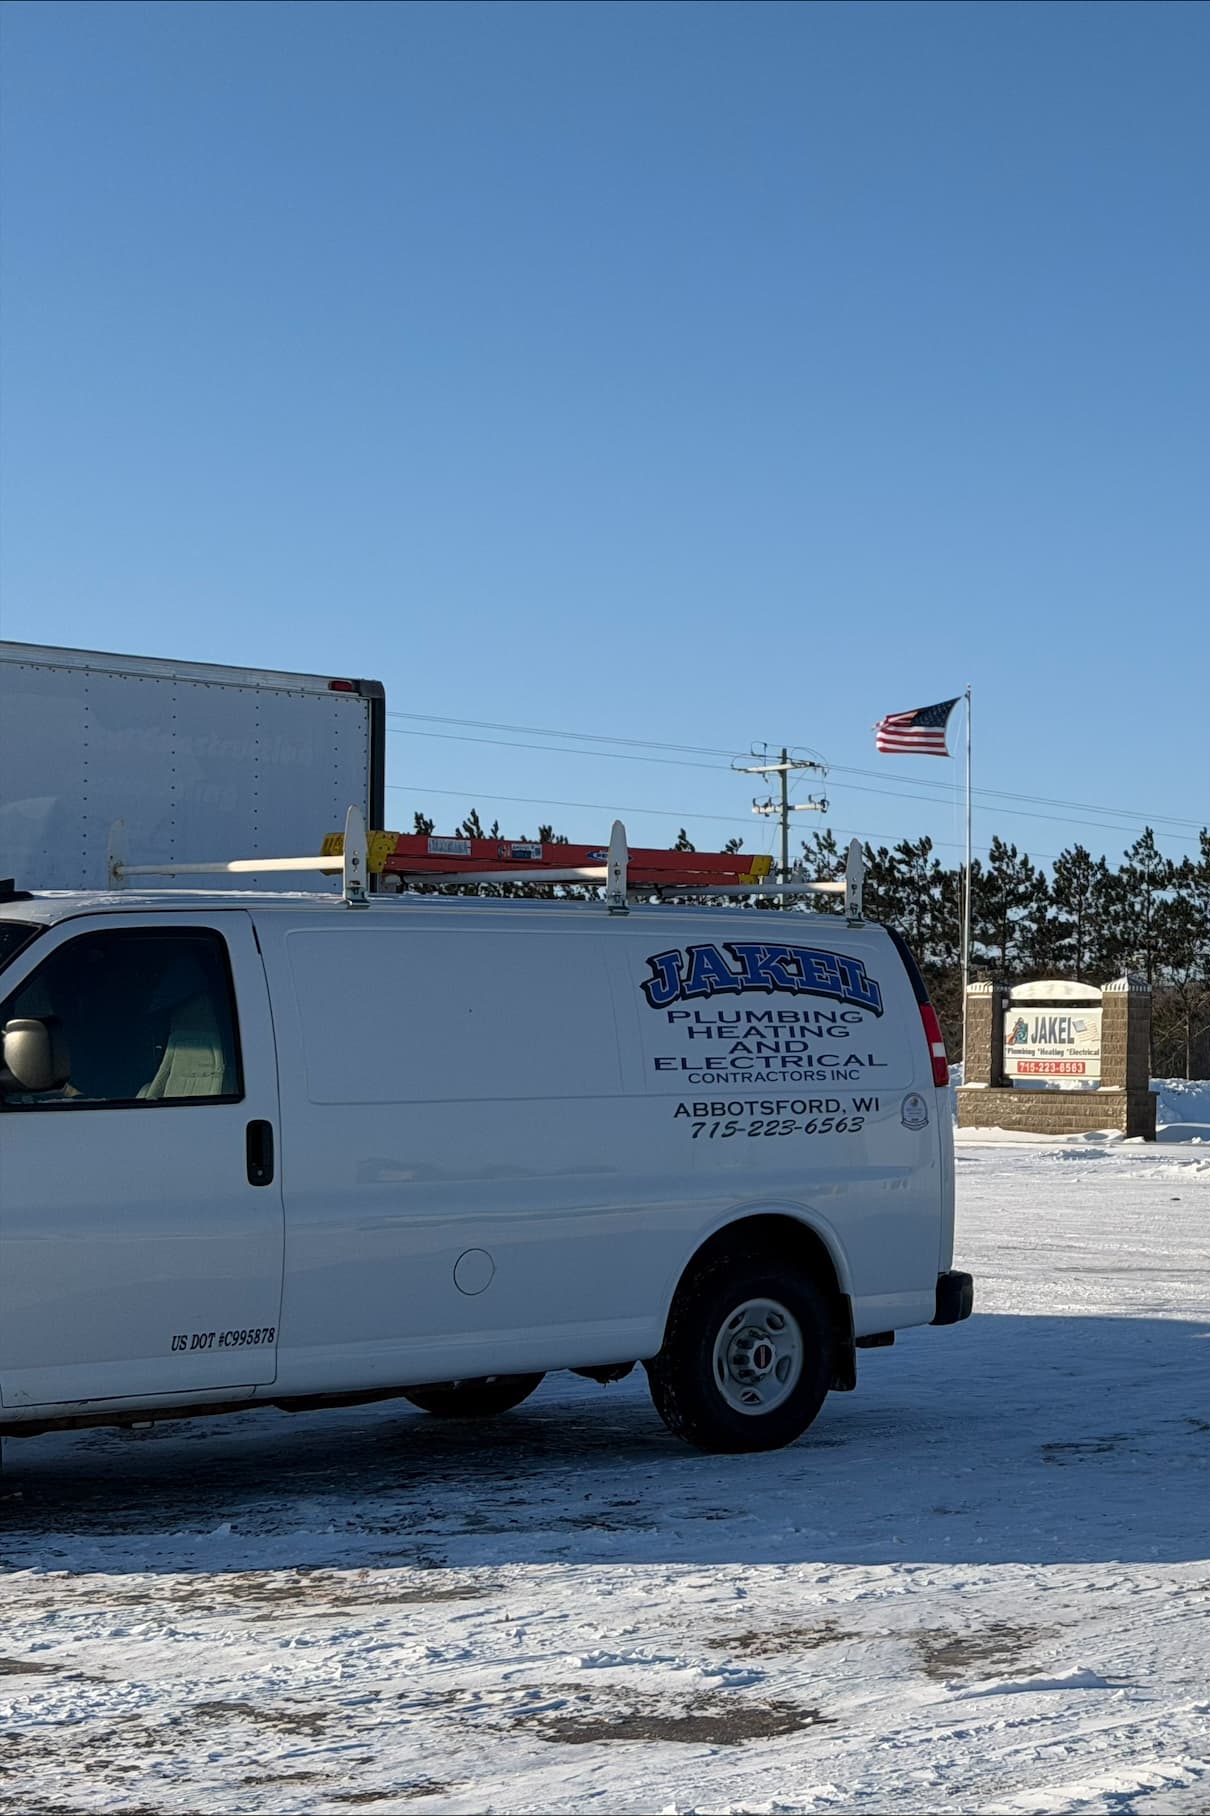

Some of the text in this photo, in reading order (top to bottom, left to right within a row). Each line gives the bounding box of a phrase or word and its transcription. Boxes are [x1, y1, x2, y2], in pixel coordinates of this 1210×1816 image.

[640, 942, 883, 1018] JAKEL
[667, 1009, 863, 1024] PLUMBING
[687, 1025, 850, 1040] HEATING
[1031, 1016, 1075, 1044] JAKEL
[728, 1040, 809, 1054] AND
[654, 1053, 888, 1071] ELECTRICAL
[688, 1069, 860, 1084] CONTRACTORS INC
[673, 1097, 880, 1119] ABBOTSFORD, WI
[691, 1116, 865, 1139] 715-223-6563
[171, 1327, 276, 1351] US DOT #C995878
